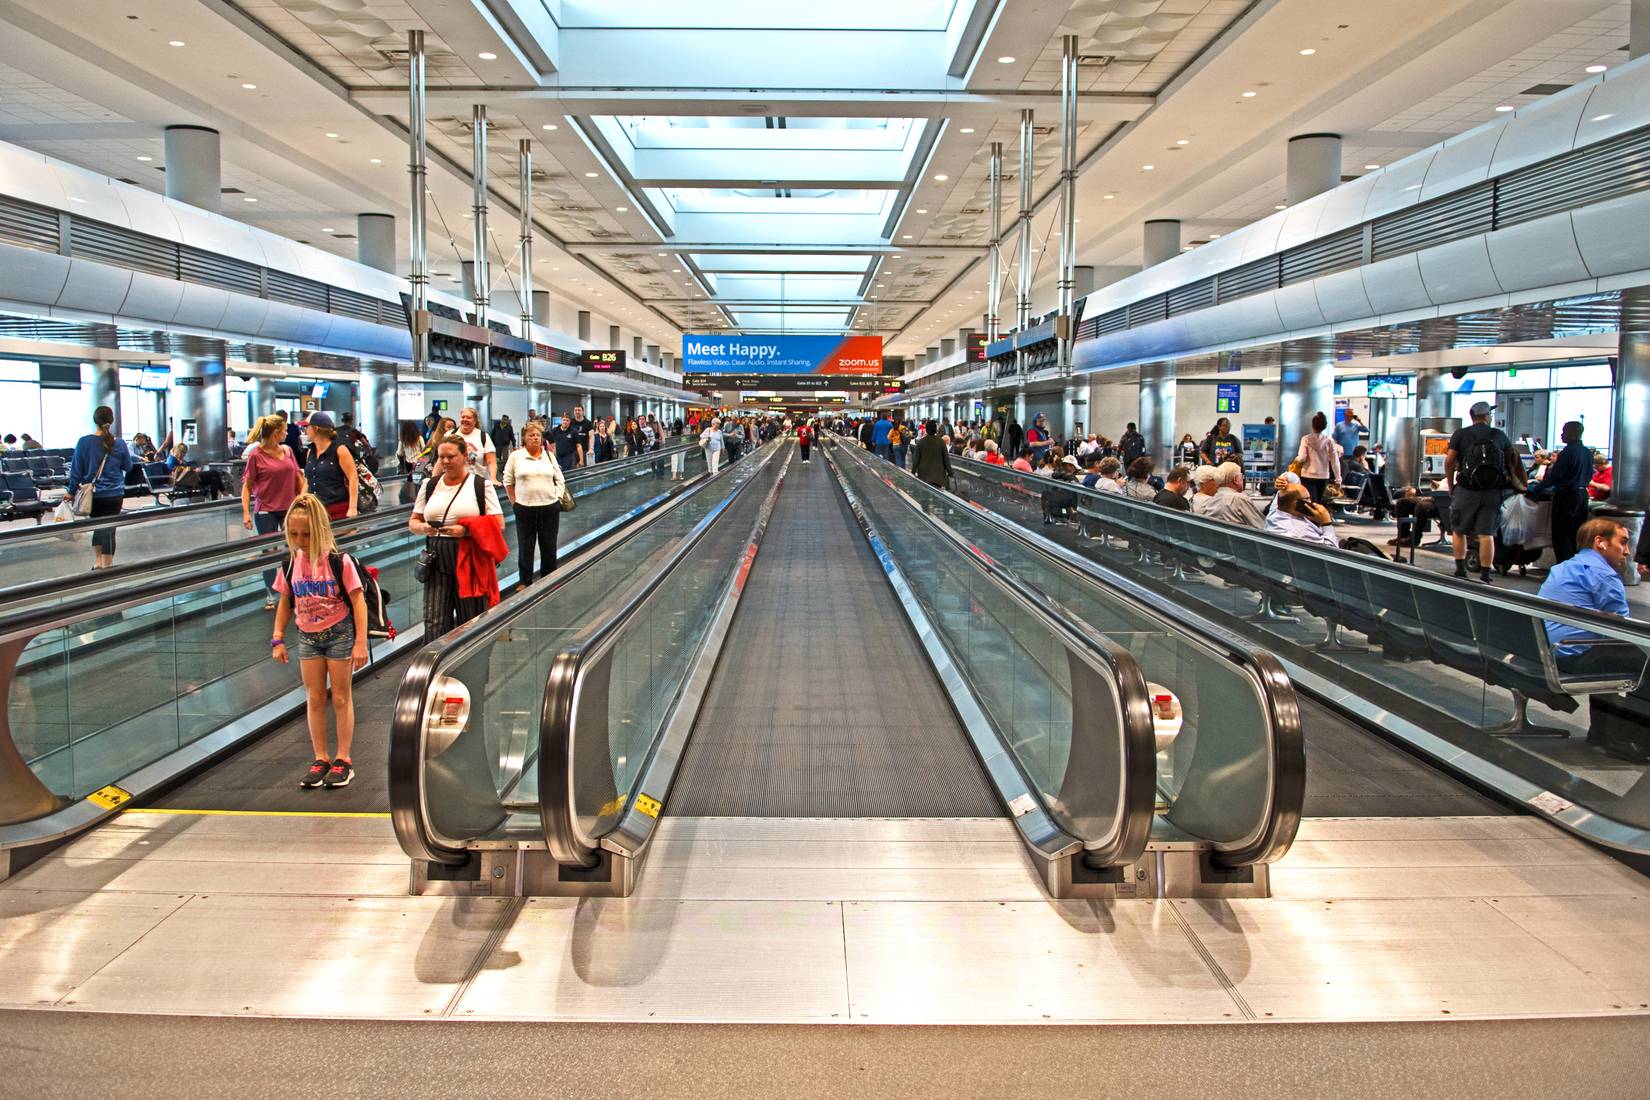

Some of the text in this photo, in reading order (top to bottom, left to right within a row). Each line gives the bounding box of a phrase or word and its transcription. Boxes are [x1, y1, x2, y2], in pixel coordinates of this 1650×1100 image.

[687, 342, 781, 359] Meet Happy.
[602, 353, 617, 362] B26
[687, 358, 712, 367] Flawless
[712, 358, 731, 367] Video.
[731, 359, 746, 367] Clear
[747, 359, 765, 367] Audio.
[766, 359, 787, 367] Instant
[838, 359, 880, 368] zoom.us
[292, 580, 336, 597] UMMIT
